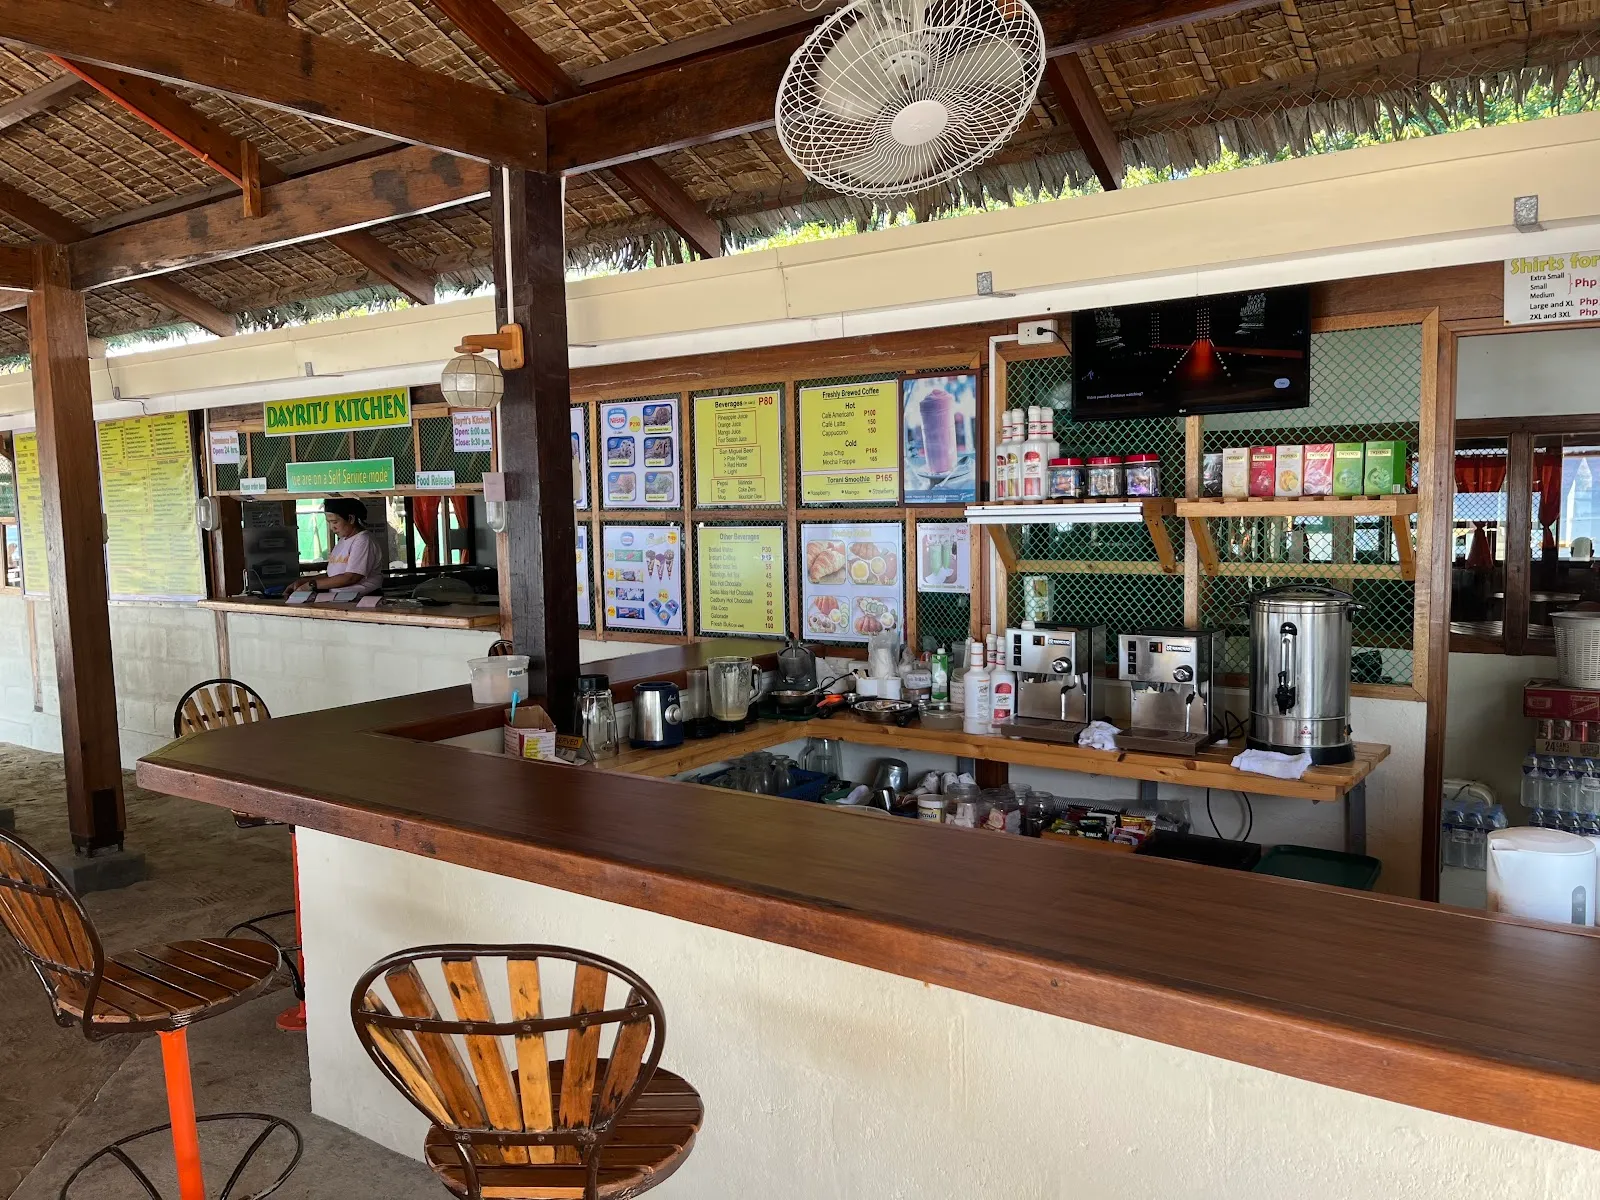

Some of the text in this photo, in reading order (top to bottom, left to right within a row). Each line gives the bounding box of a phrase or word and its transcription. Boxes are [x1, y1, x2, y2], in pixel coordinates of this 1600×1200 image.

[1511, 252, 1600, 275] Shirts for
[1575, 278, 1597, 288] Php
[1580, 298, 1598, 306] Php
[1580, 309, 1598, 317] Php
[822, 387, 880, 399] Freshly Brewed Coffee
[758, 397, 773, 405] P80
[266, 393, 406, 428] DAYRIT'S KITCHEN
[863, 409, 876, 417] P100
[454, 415, 490, 426] Dayrit's Kitchen
[455, 428, 469, 436] Open:
[455, 438, 470, 446] Close:
[844, 439, 857, 447] Cold
[224, 446, 230, 454] 24
[729, 448, 743, 456] Miguel
[302, 474, 311, 486] are
[314, 474, 321, 485] on
[329, 469, 340, 485] Self
[343, 469, 367, 484] Service
[417, 474, 453, 486] Food Release
[844, 475, 870, 483] Smoothie
[875, 473, 893, 482] P165
[734, 532, 760, 542] Beverages
[1545, 741, 1555, 752] 24
